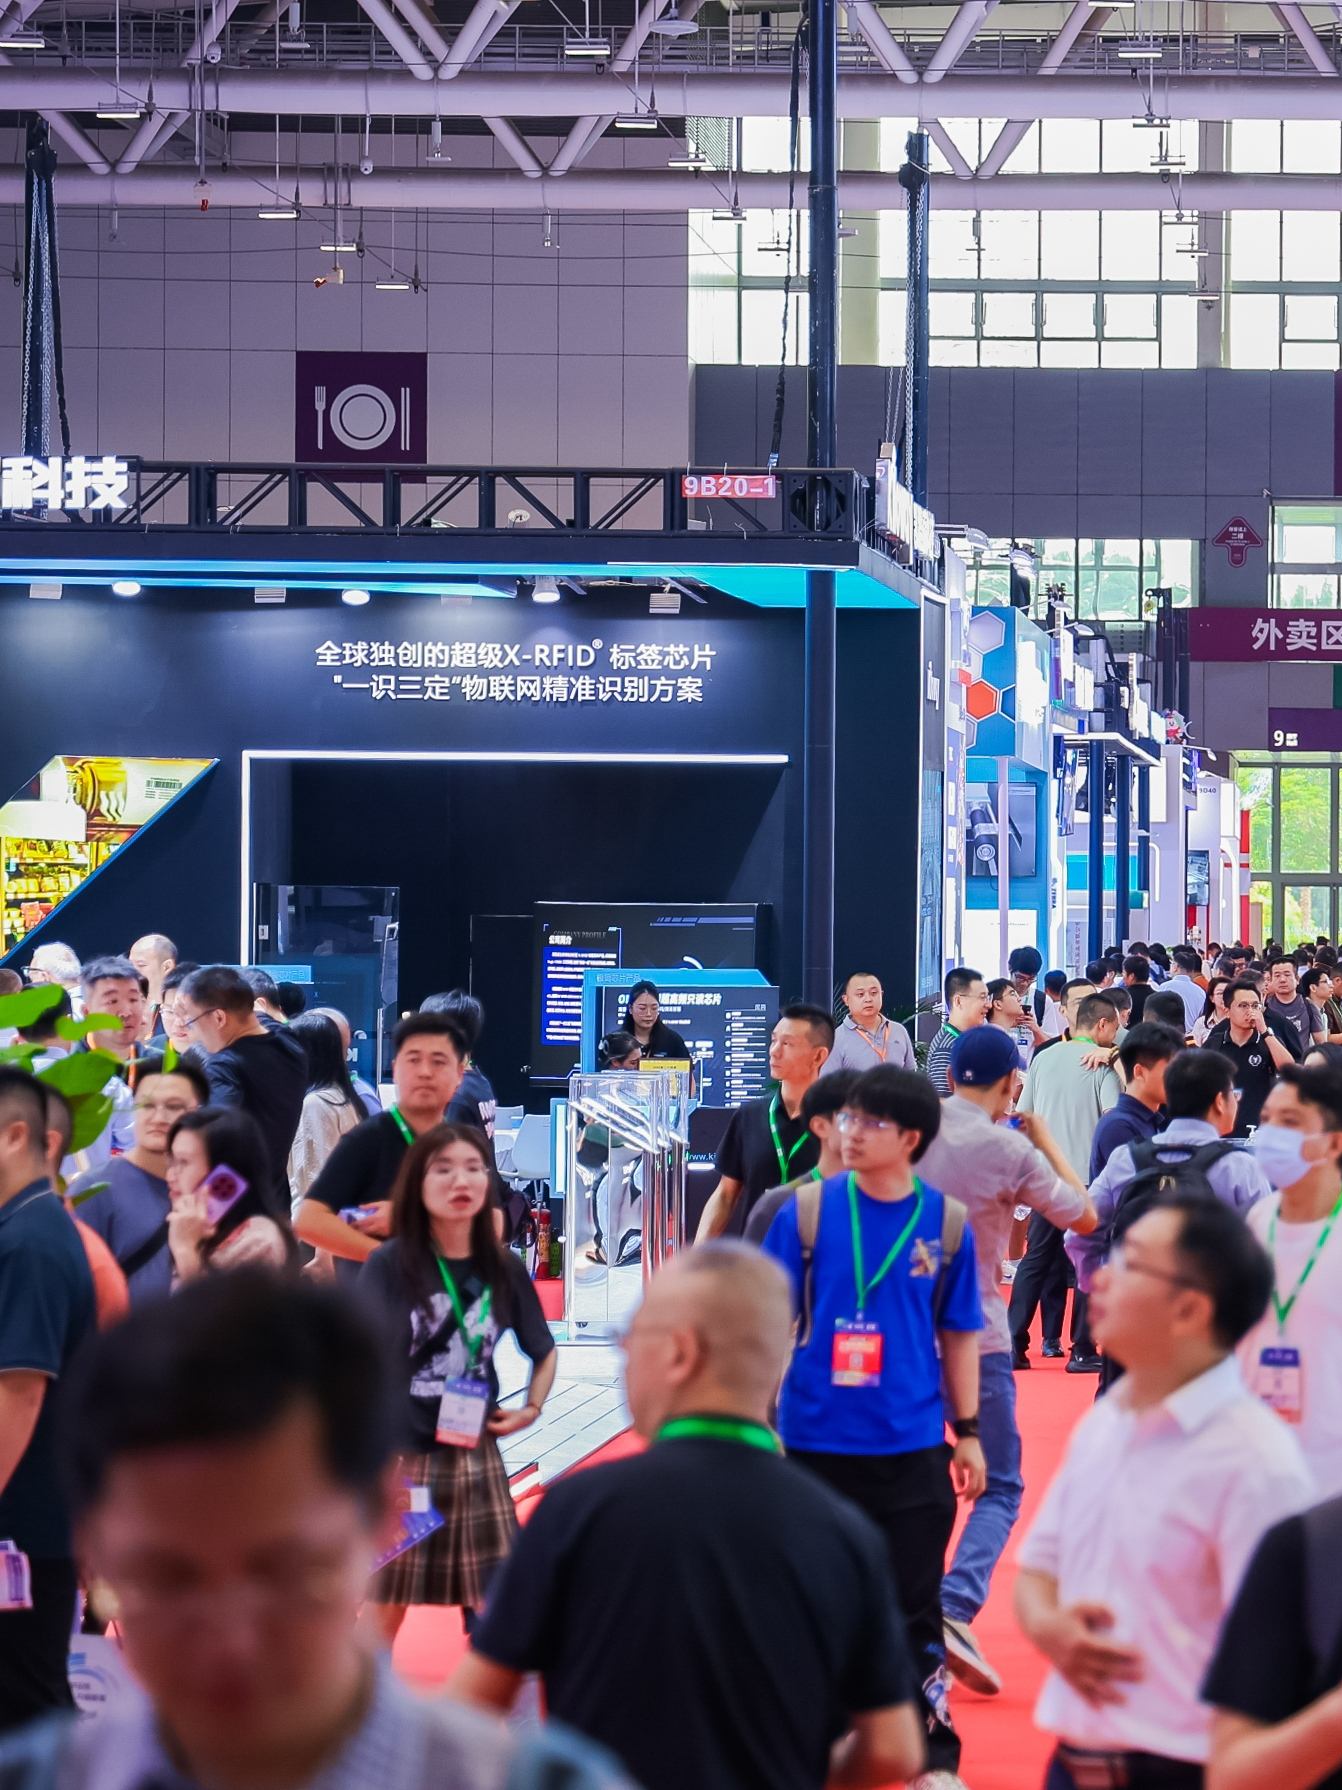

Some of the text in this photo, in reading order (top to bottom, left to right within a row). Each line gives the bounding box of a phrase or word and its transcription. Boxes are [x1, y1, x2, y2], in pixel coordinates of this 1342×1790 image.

[2, 456, 129, 509] 科技
[609, 643, 717, 670] 标签芯片
[1273, 730, 1284, 746] 9
